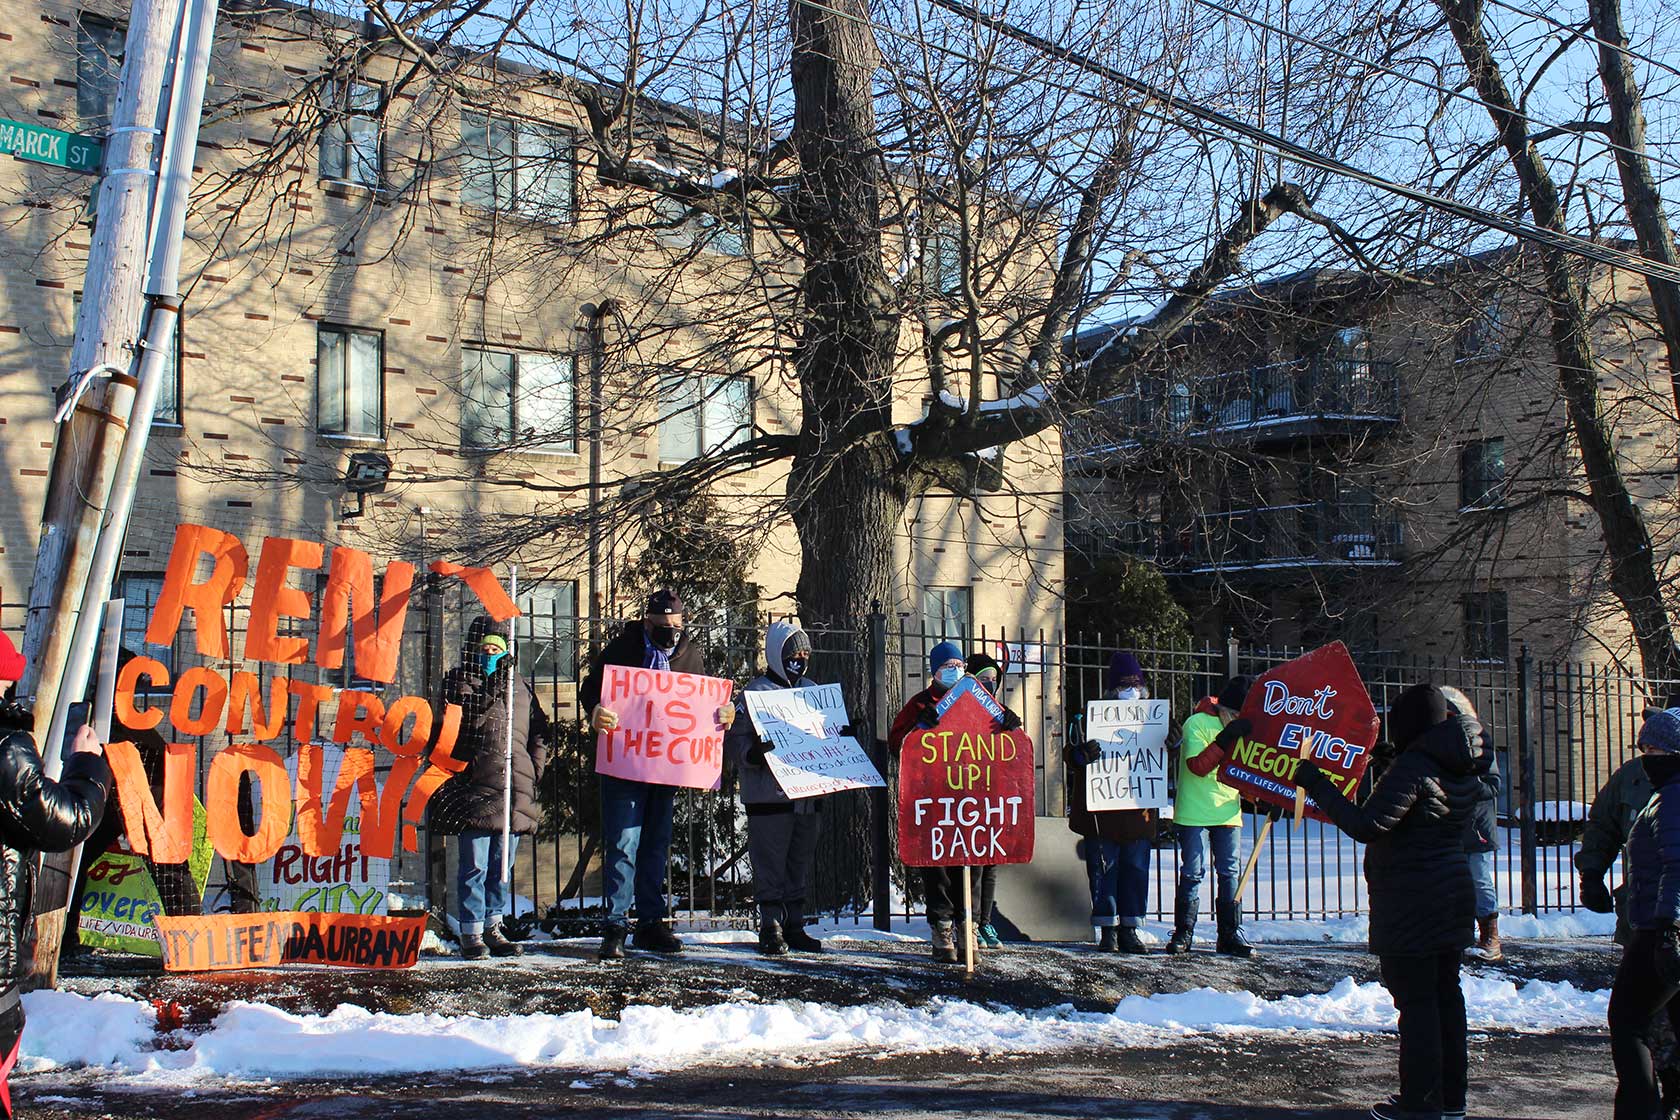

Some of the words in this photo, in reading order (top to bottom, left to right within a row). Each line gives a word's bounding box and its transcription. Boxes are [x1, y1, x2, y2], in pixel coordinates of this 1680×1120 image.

[0, 124, 61, 160] MARCK
[70, 146, 89, 165] ST
[794, 687, 844, 715] COVID
[941, 692, 958, 710] LIFE
[971, 683, 988, 705] VIDA
[1264, 680, 1337, 720] Don't
[115, 655, 467, 772] CONTROL
[645, 700, 697, 735] IS
[1090, 705, 1163, 722] HOUSING
[604, 726, 664, 763] THE
[667, 736, 722, 769] CURE
[921, 731, 1016, 763] STAND
[1110, 729, 1123, 745] IS
[1126, 730, 1138, 746] A
[1278, 723, 1366, 769] EVICT
[947, 764, 990, 791] UP!
[1090, 775, 1163, 803] RIGHT
[1229, 767, 1251, 782] CITY
[914, 796, 1022, 826] FIGHT
[931, 825, 1007, 860] BACK
[162, 929, 199, 967] ITY
